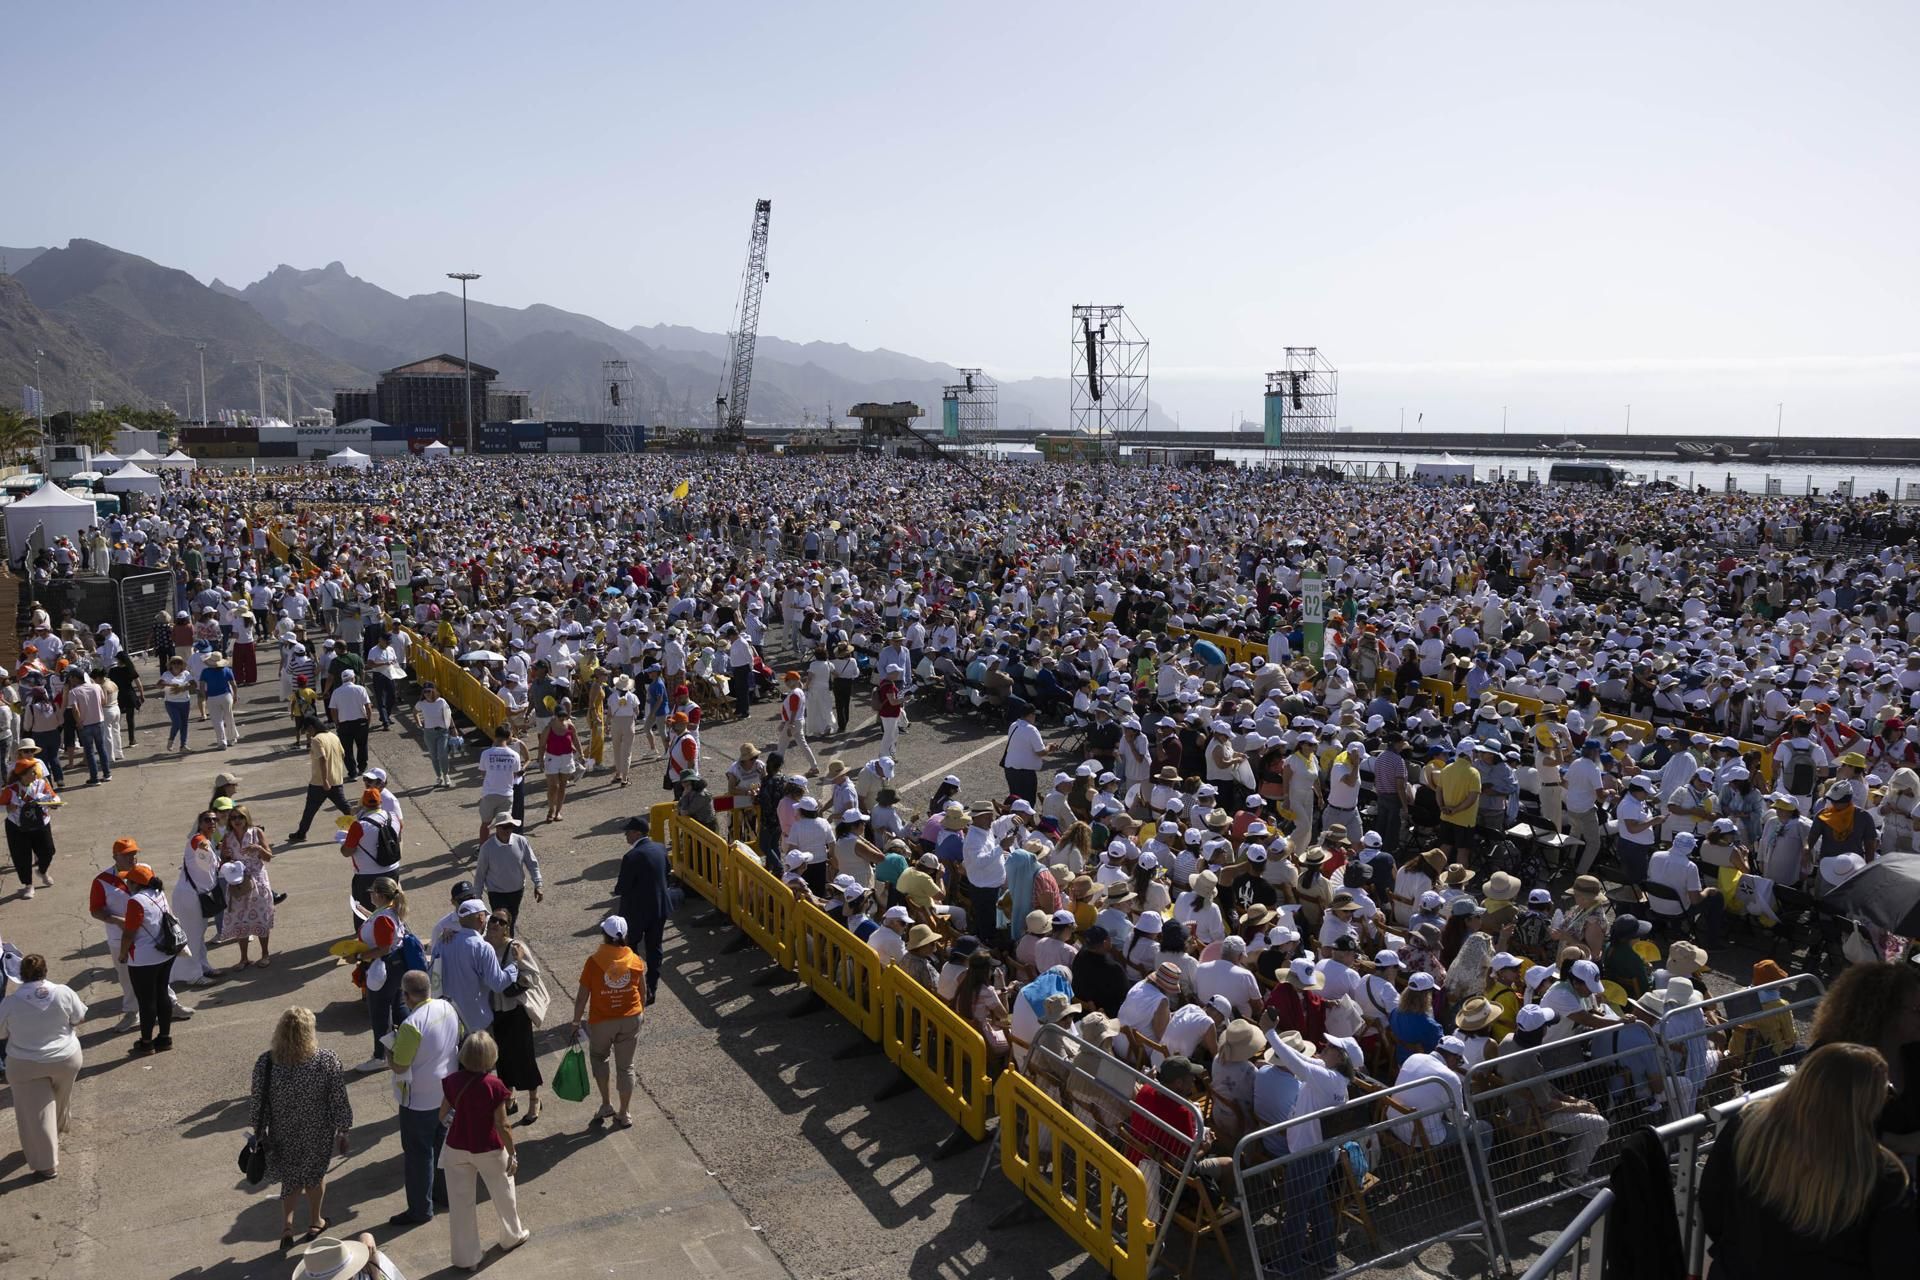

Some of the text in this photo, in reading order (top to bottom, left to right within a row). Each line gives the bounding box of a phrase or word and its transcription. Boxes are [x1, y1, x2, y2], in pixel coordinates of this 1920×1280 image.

[519, 441, 542, 449] WEC
[395, 563, 407, 580] C1
[1304, 583, 1320, 592] SECTOR
[1304, 595, 1320, 616] C2
